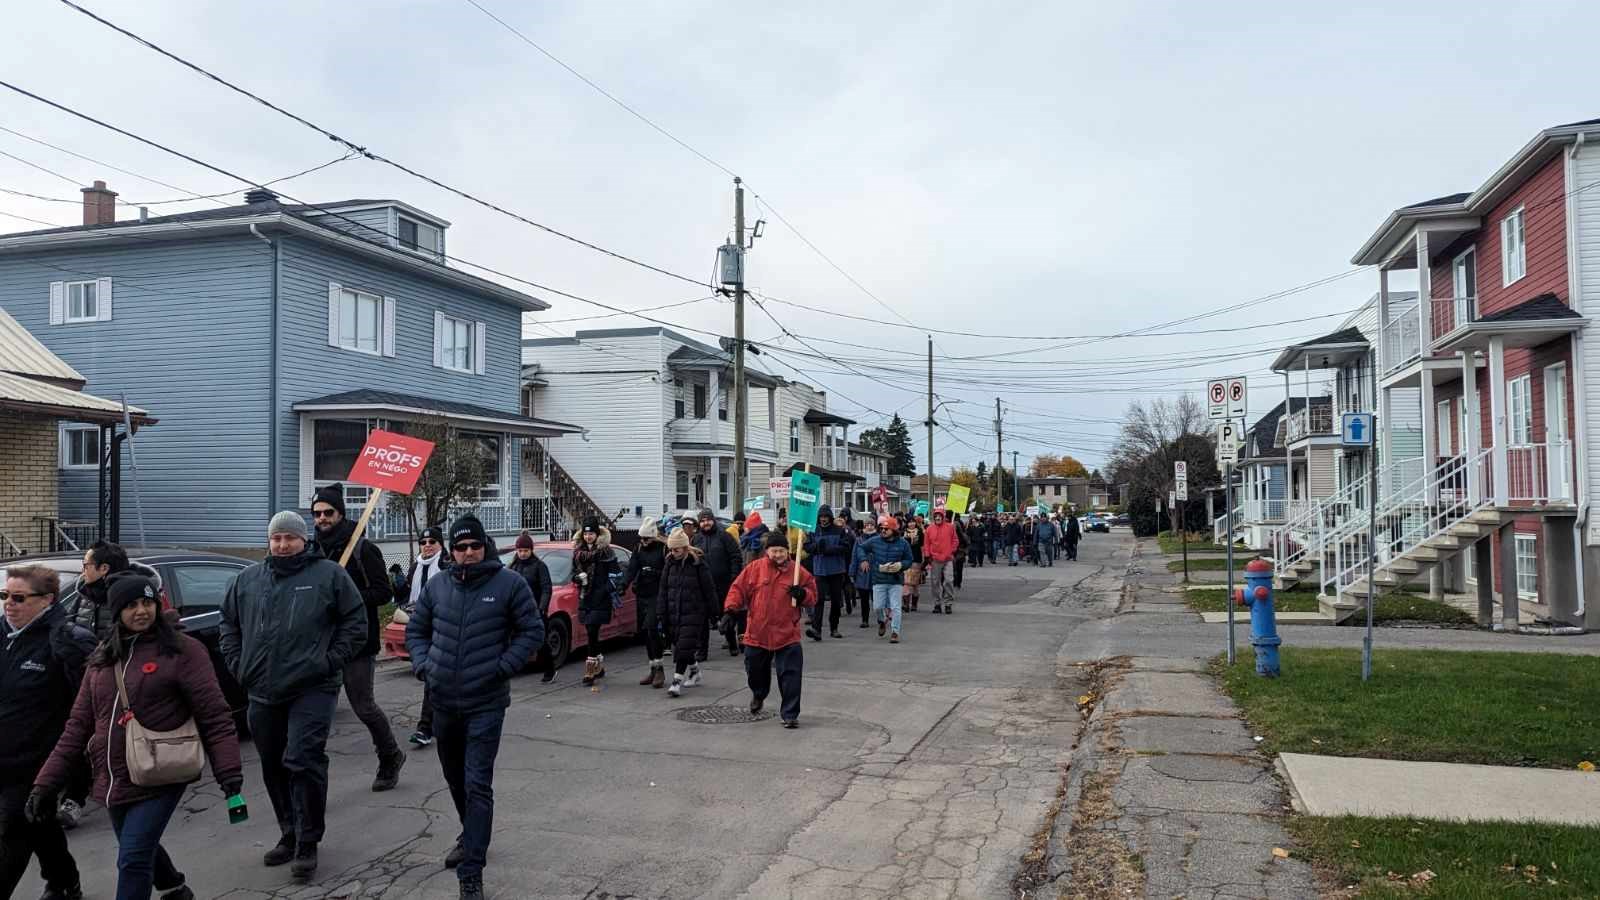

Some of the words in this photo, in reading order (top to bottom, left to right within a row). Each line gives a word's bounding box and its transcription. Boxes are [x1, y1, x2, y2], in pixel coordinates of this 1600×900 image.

[1214, 387, 1222, 399] P
[1223, 427, 1232, 441] P
[363, 446, 422, 468] PROFS
[382, 463, 408, 474] NÉGO
